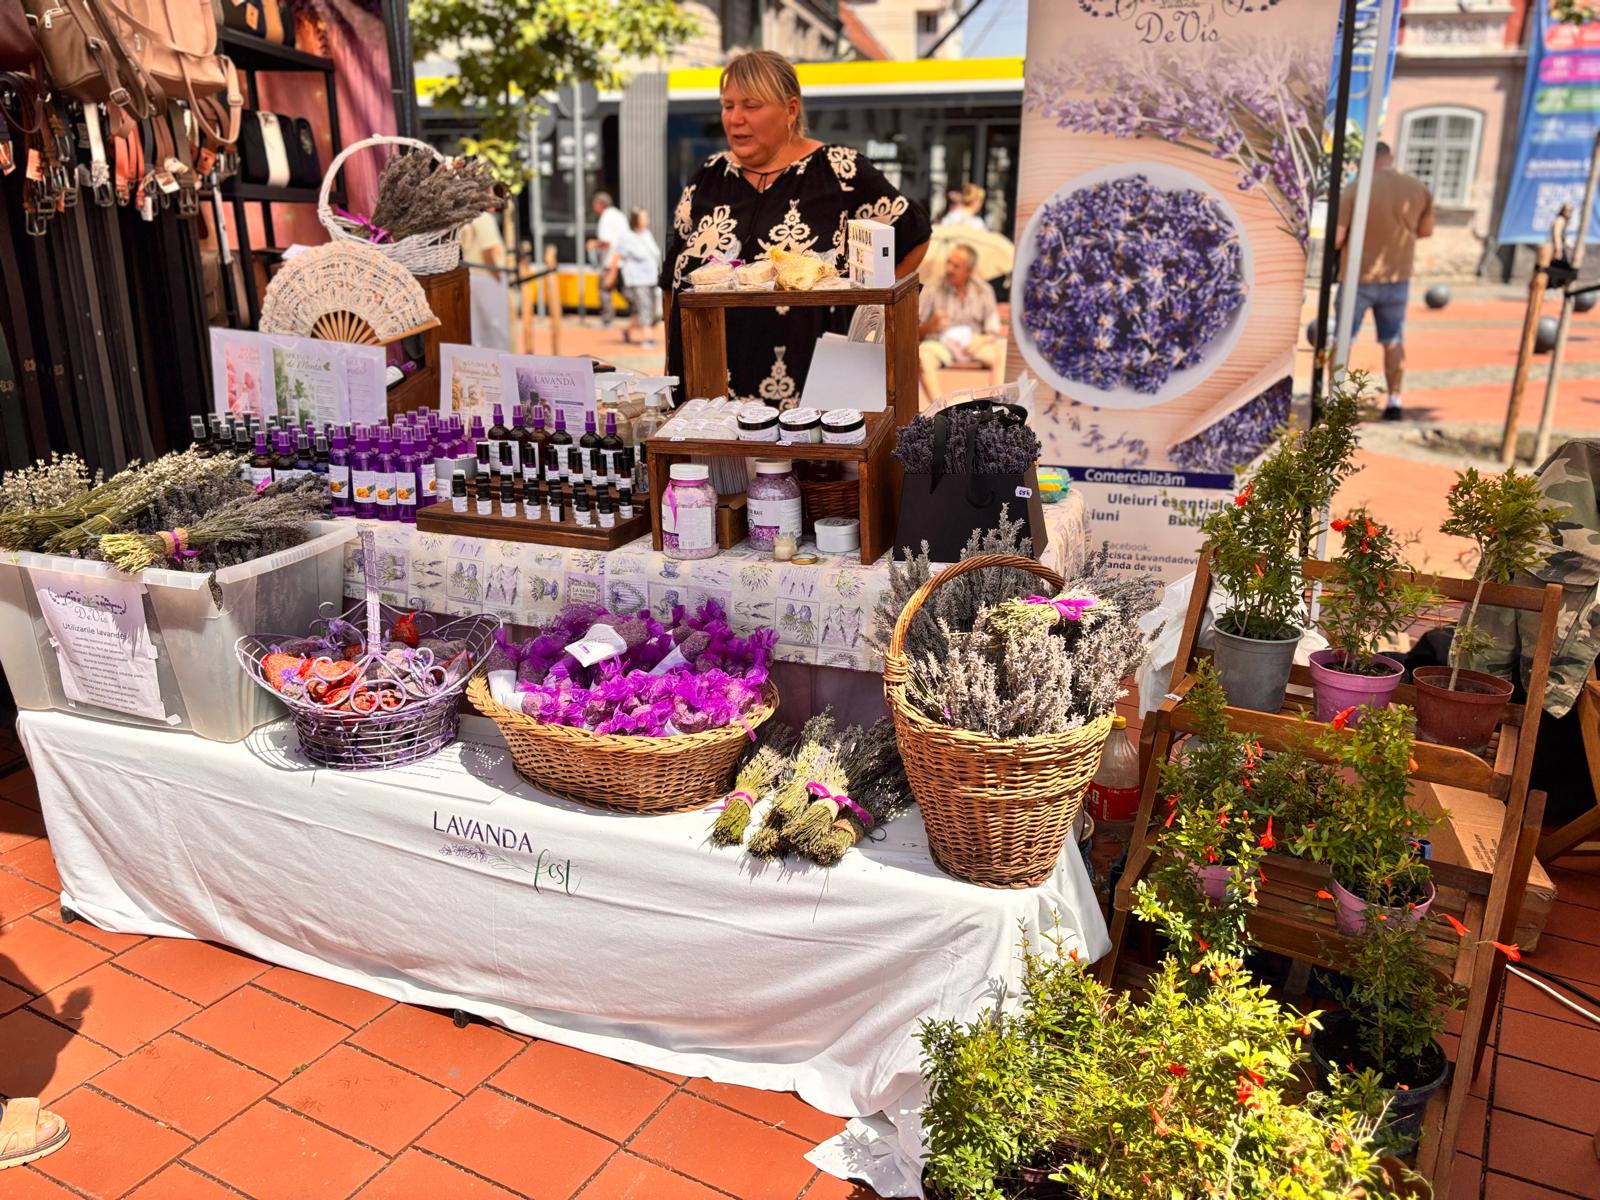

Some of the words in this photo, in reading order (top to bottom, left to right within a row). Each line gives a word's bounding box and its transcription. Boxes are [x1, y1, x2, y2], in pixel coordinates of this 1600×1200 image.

[1084, 468, 1186, 486] Comercializăm
[1107, 493, 1158, 507] Uleiuri
[1090, 508, 1120, 521] iuni
[1135, 553, 1198, 565] Lavandadevi
[1133, 562, 1146, 571] de
[433, 810, 533, 854] LAVANDA
